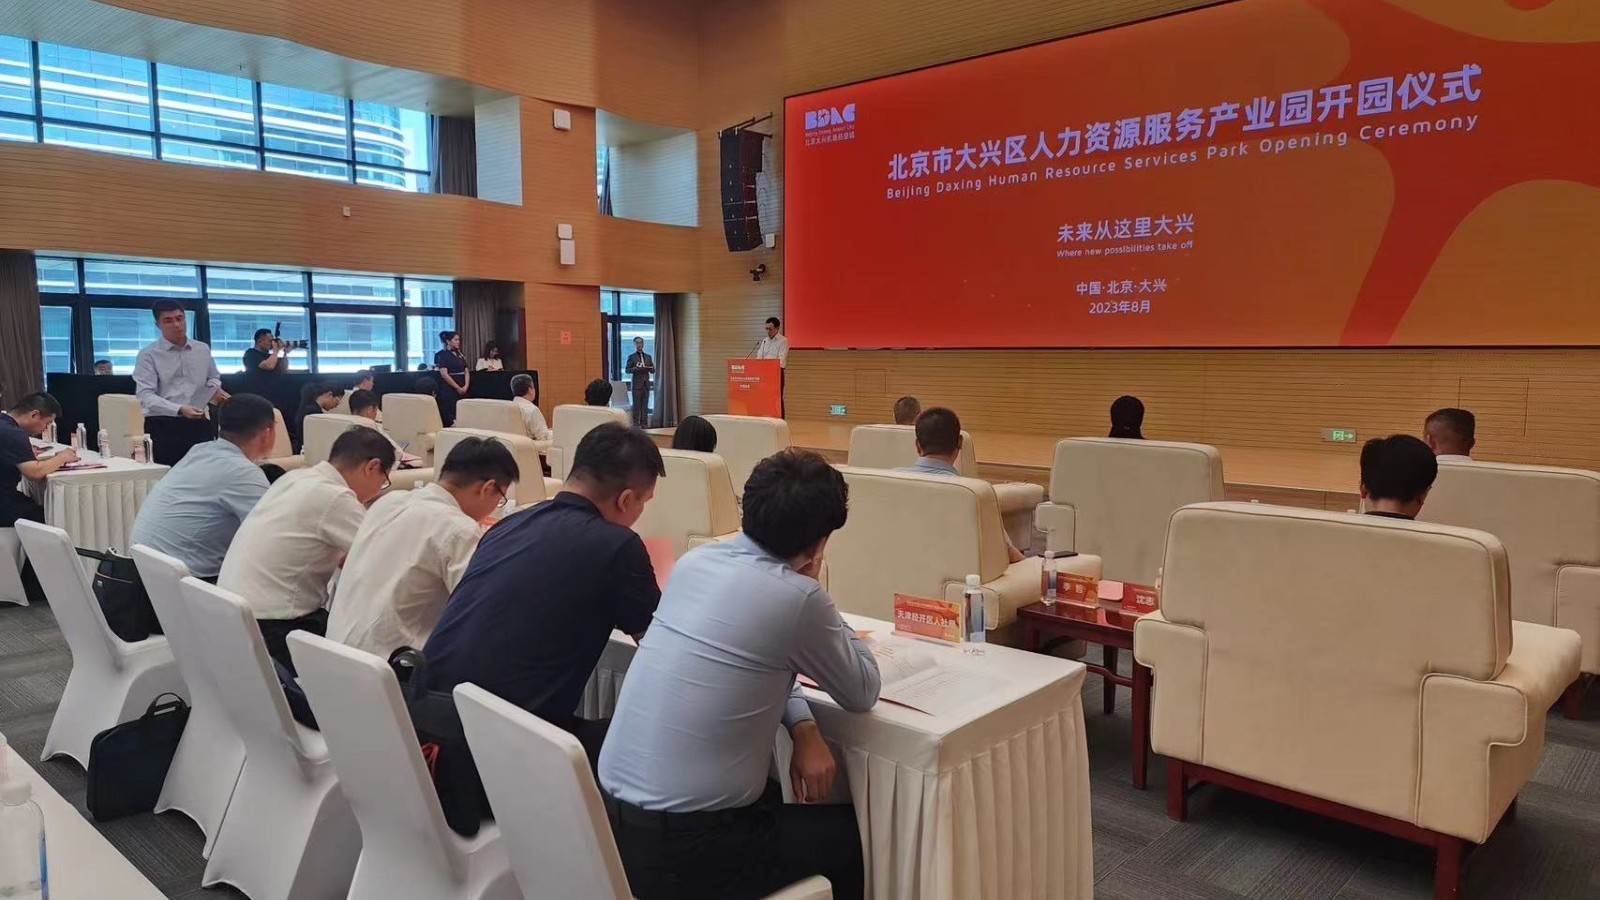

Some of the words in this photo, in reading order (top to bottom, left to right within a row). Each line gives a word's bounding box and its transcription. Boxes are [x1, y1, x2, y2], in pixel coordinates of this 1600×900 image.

[805, 103, 856, 130] BDAC
[888, 63, 1482, 181] 北京市大兴区人力资源服务产业园开园仪式
[887, 185, 930, 200] Beijing
[936, 179, 982, 194] Daxing
[989, 171, 1038, 187] Human
[1045, 161, 1116, 179] Resource
[1124, 151, 1197, 170] Services
[1207, 144, 1248, 160] Park
[1259, 130, 1348, 154] Opening
[1360, 113, 1478, 141] Ceremony
[1057, 213, 1195, 244] 未来从这里大兴
[1056, 249, 1082, 258] Where
[1085, 248, 1102, 256] new
[1104, 243, 1155, 256] possibilities
[1158, 242, 1178, 251] take
[1180, 240, 1194, 249] off
[1089, 299, 1151, 315] 2023年8月
